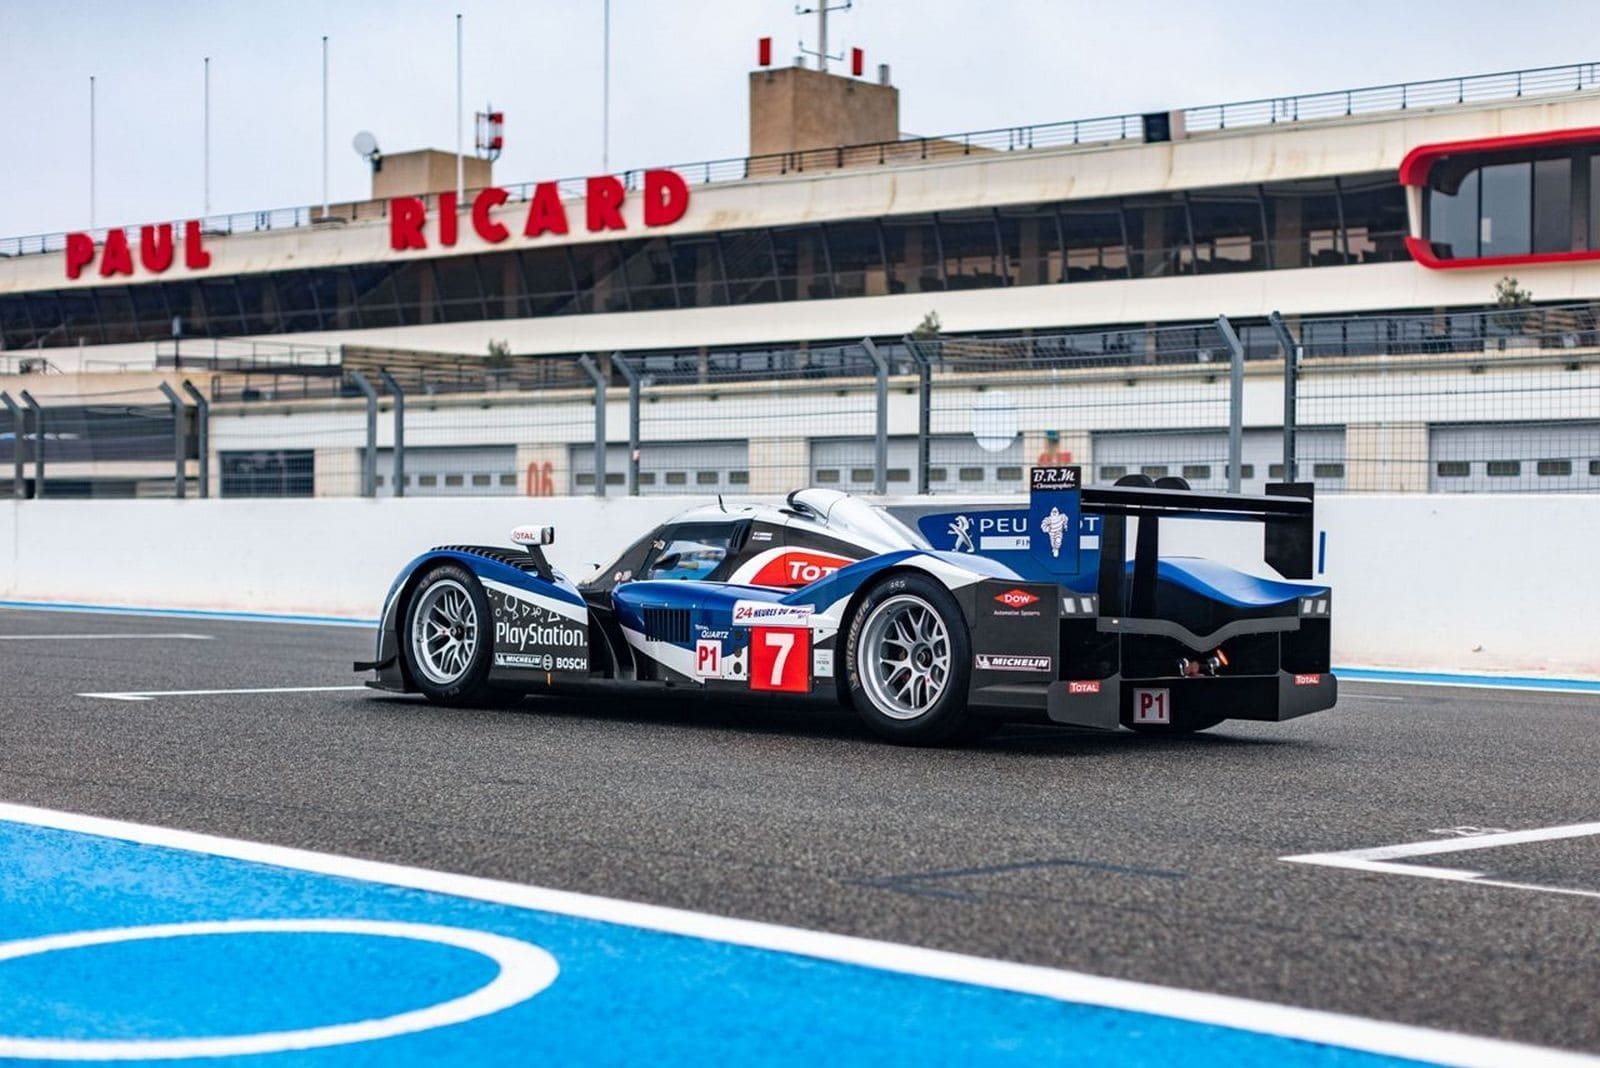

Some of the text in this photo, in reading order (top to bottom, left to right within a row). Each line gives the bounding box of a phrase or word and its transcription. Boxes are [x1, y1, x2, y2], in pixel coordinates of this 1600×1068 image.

[66, 168, 690, 280] PAUL RICARD
[735, 607, 753, 620] 24
[701, 630, 729, 639] QUARTZ
[505, 655, 541, 664] MICHELIN
[556, 657, 588, 670] BOSCH
[699, 645, 717, 671] P1
[765, 632, 795, 686] 7
[992, 657, 1048, 668] MICHELIN
[1295, 675, 1320, 685] TOTAL
[1070, 682, 1099, 692] TOTAL
[1141, 693, 1164, 718] P1
